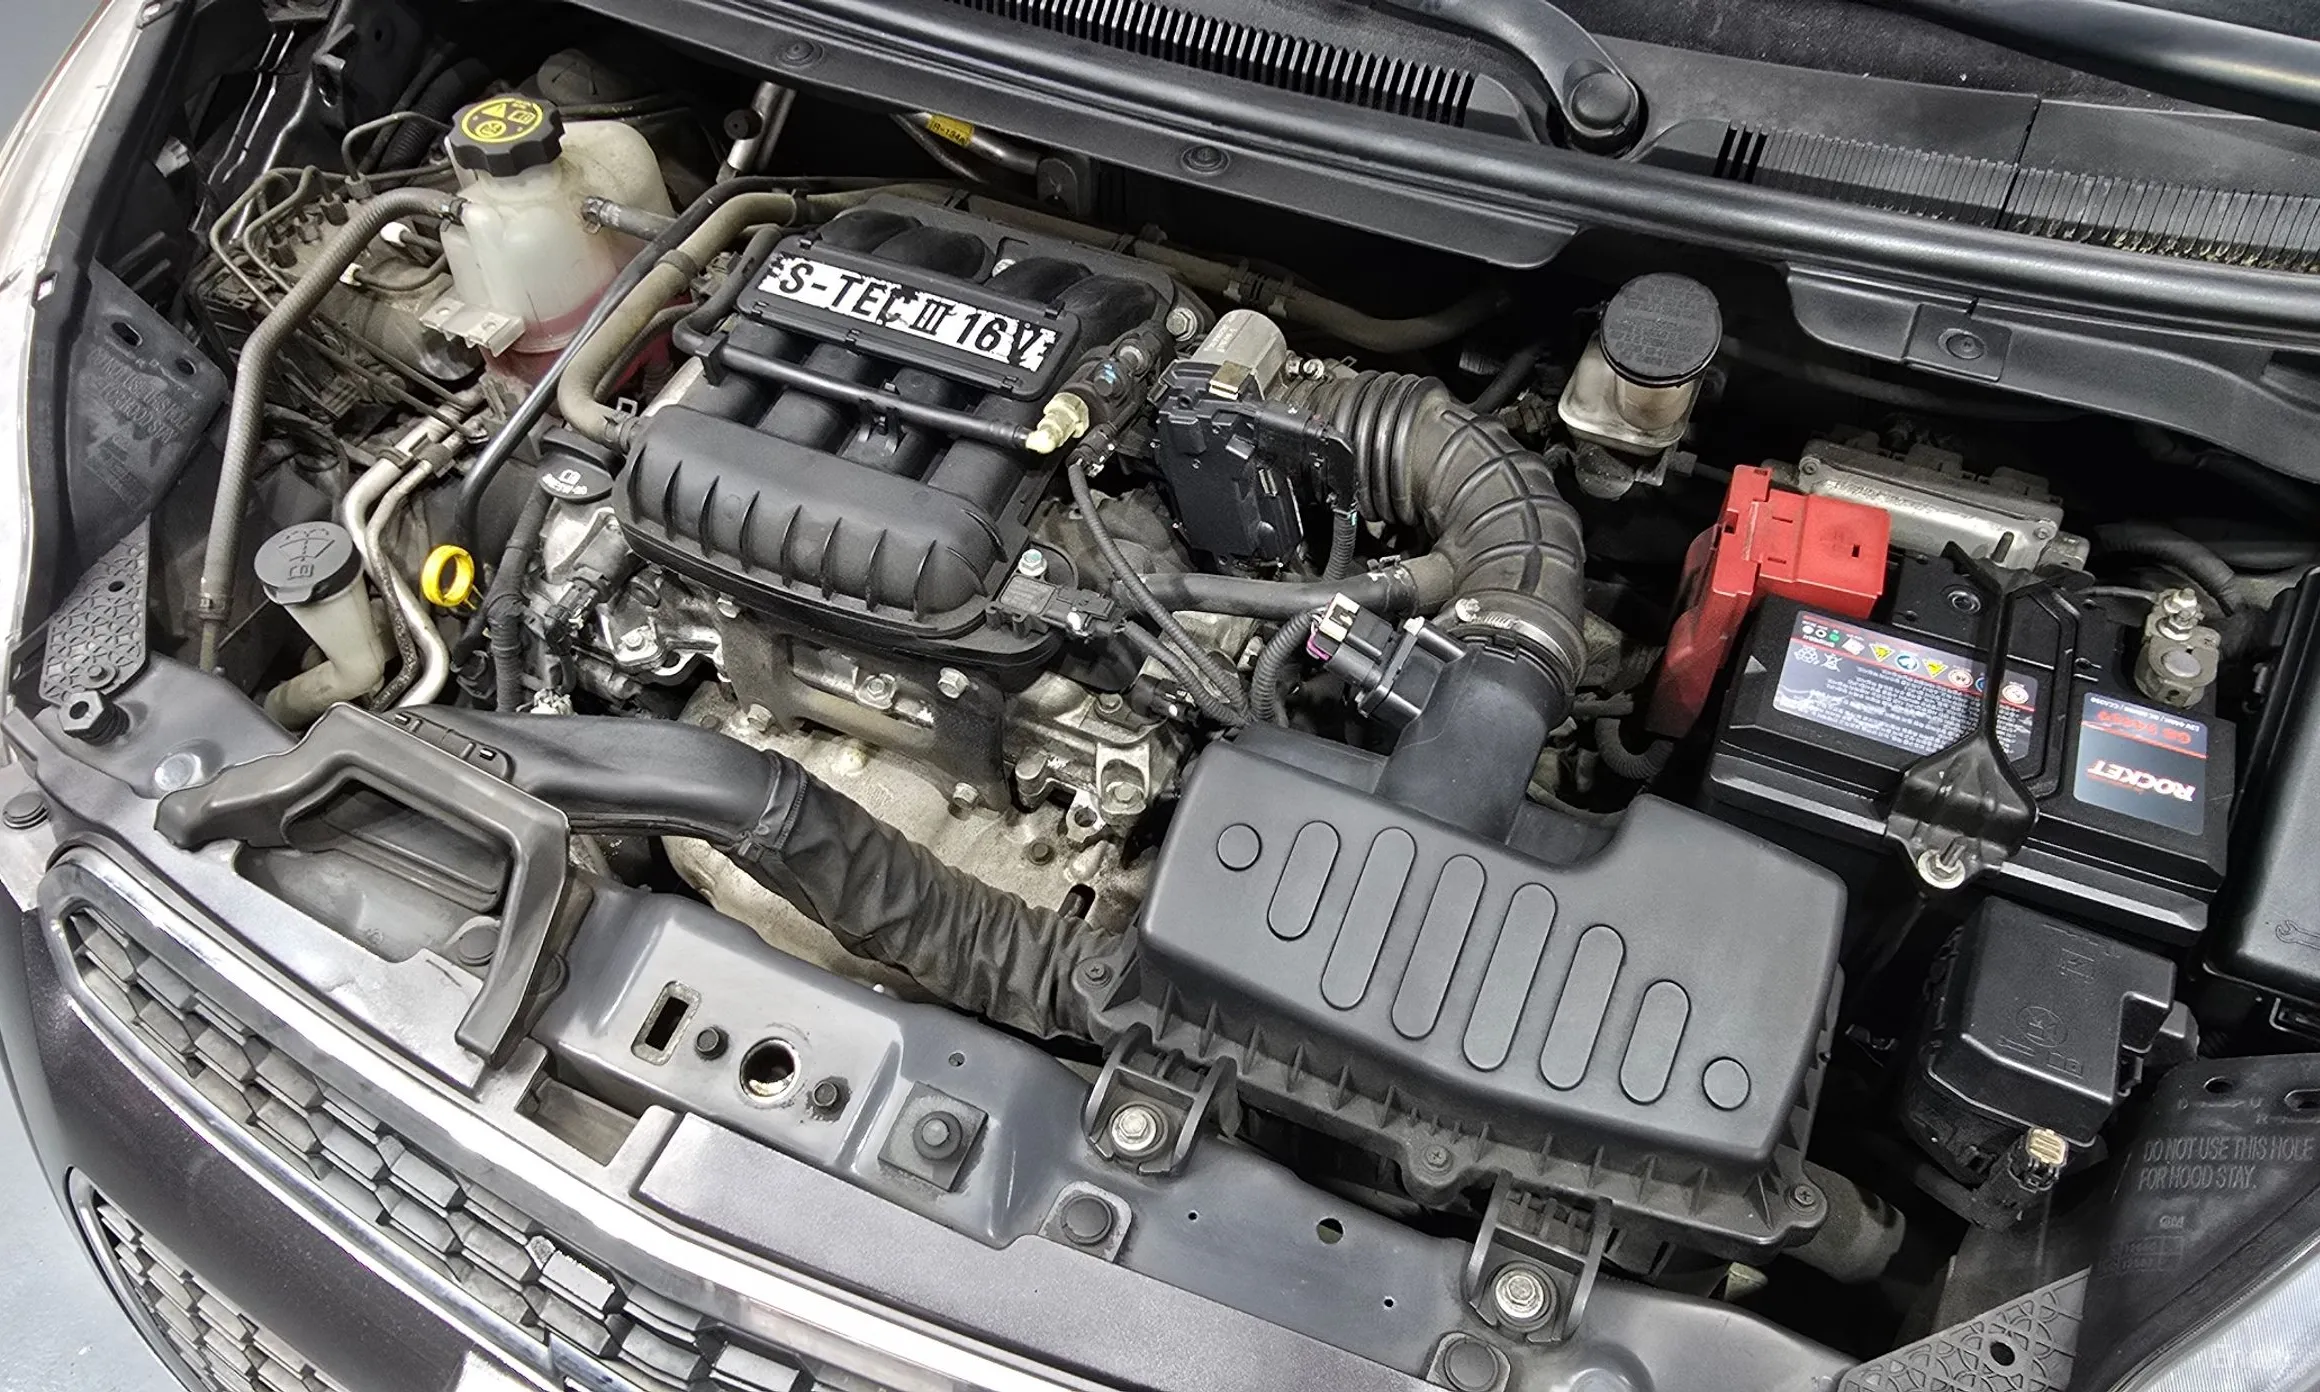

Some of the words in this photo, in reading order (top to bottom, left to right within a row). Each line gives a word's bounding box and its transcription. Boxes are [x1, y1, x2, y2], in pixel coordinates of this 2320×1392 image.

[779, 263, 917, 327] S-TEC
[957, 312, 1043, 364] 16V
[2087, 760, 2196, 801] ROCKET
[2143, 1139, 2164, 1161] DO
[2166, 1138, 2197, 1161] NOT
[2199, 1138, 2230, 1161] USE
[2233, 1137, 2268, 1160] THIS
[2270, 1137, 2315, 1160] HOLE
[2138, 1168, 2168, 1191] FOR
[2168, 1166, 2214, 1190] HOOD
